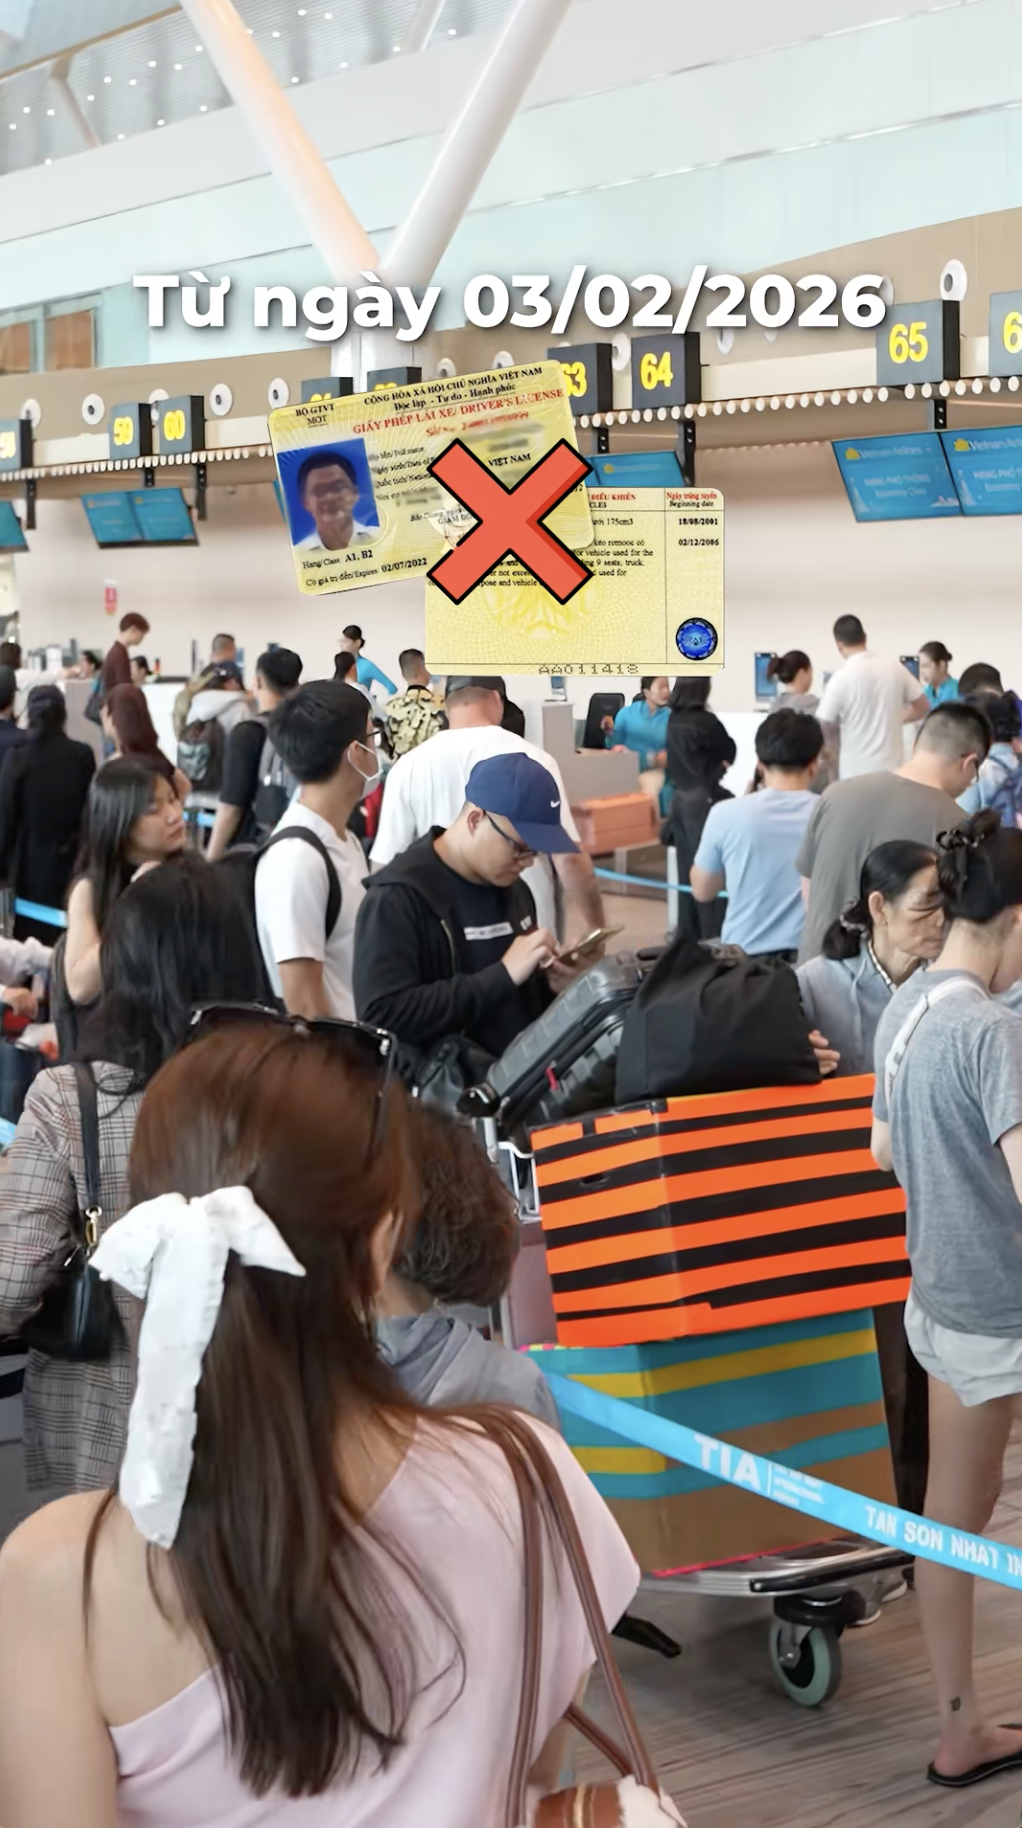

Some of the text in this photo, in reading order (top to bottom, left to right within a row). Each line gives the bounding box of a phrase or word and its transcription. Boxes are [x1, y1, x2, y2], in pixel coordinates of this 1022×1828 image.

[889, 321, 929, 364] 65
[641, 351, 674, 390] 64
[694, 1432, 761, 1490] TIA
[864, 1504, 897, 1538] TAN
[903, 1519, 944, 1553] SON
[950, 1533, 999, 1570] NHAT
